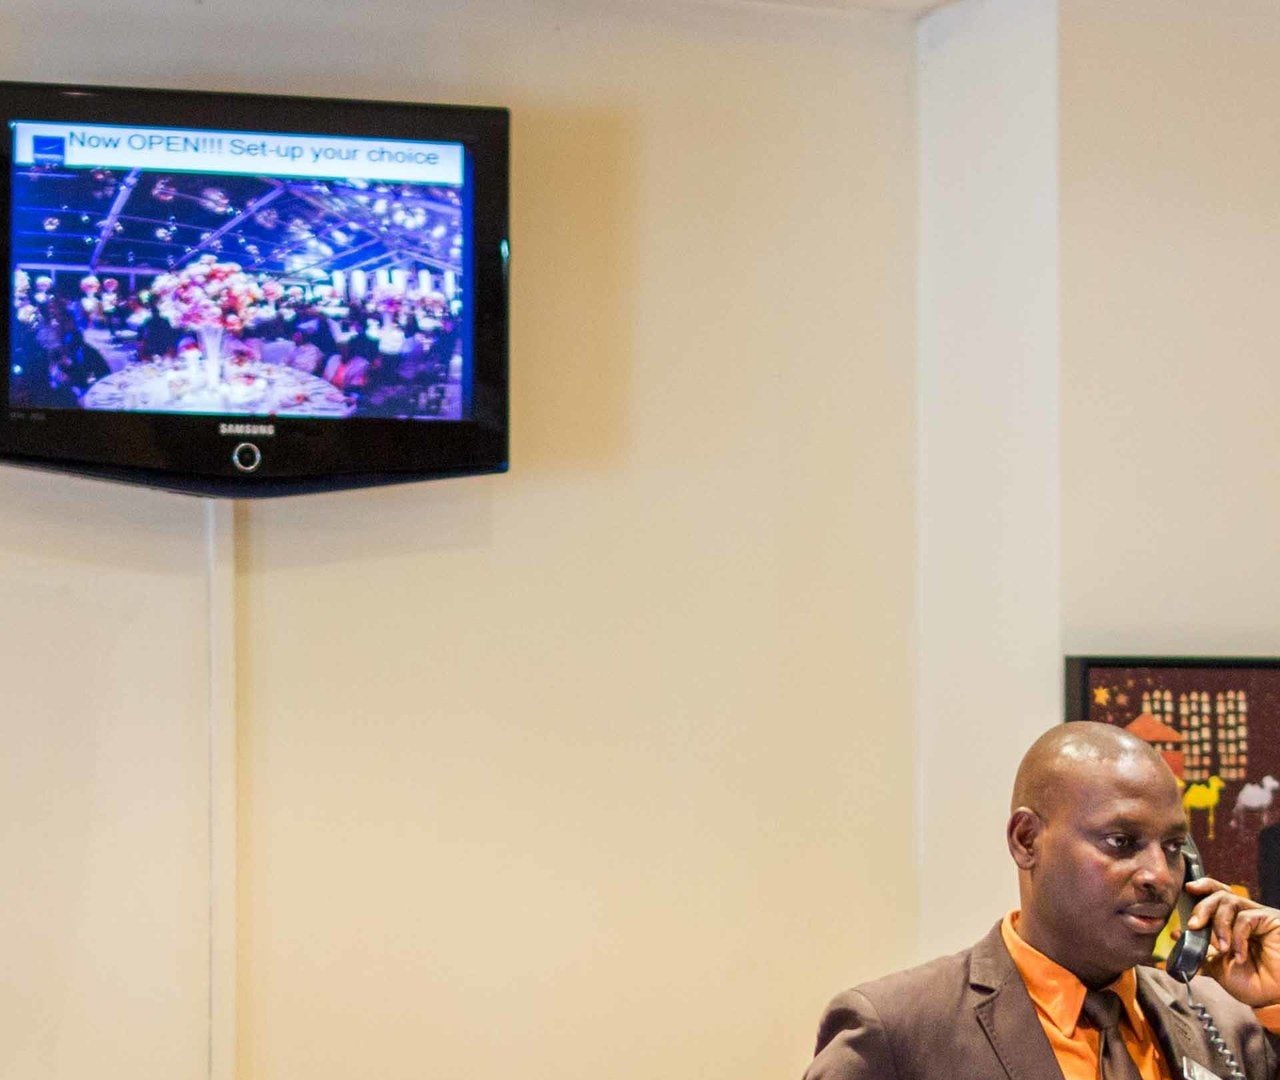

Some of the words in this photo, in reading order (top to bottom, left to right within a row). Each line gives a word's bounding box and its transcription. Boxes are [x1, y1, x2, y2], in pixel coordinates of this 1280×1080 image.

[69, 131, 120, 148] Now
[128, 133, 222, 155] OPEN!!!
[229, 138, 304, 162] Set-up
[311, 145, 359, 163] your
[366, 146, 440, 165] choice
[219, 423, 275, 435] SAMSUNG
